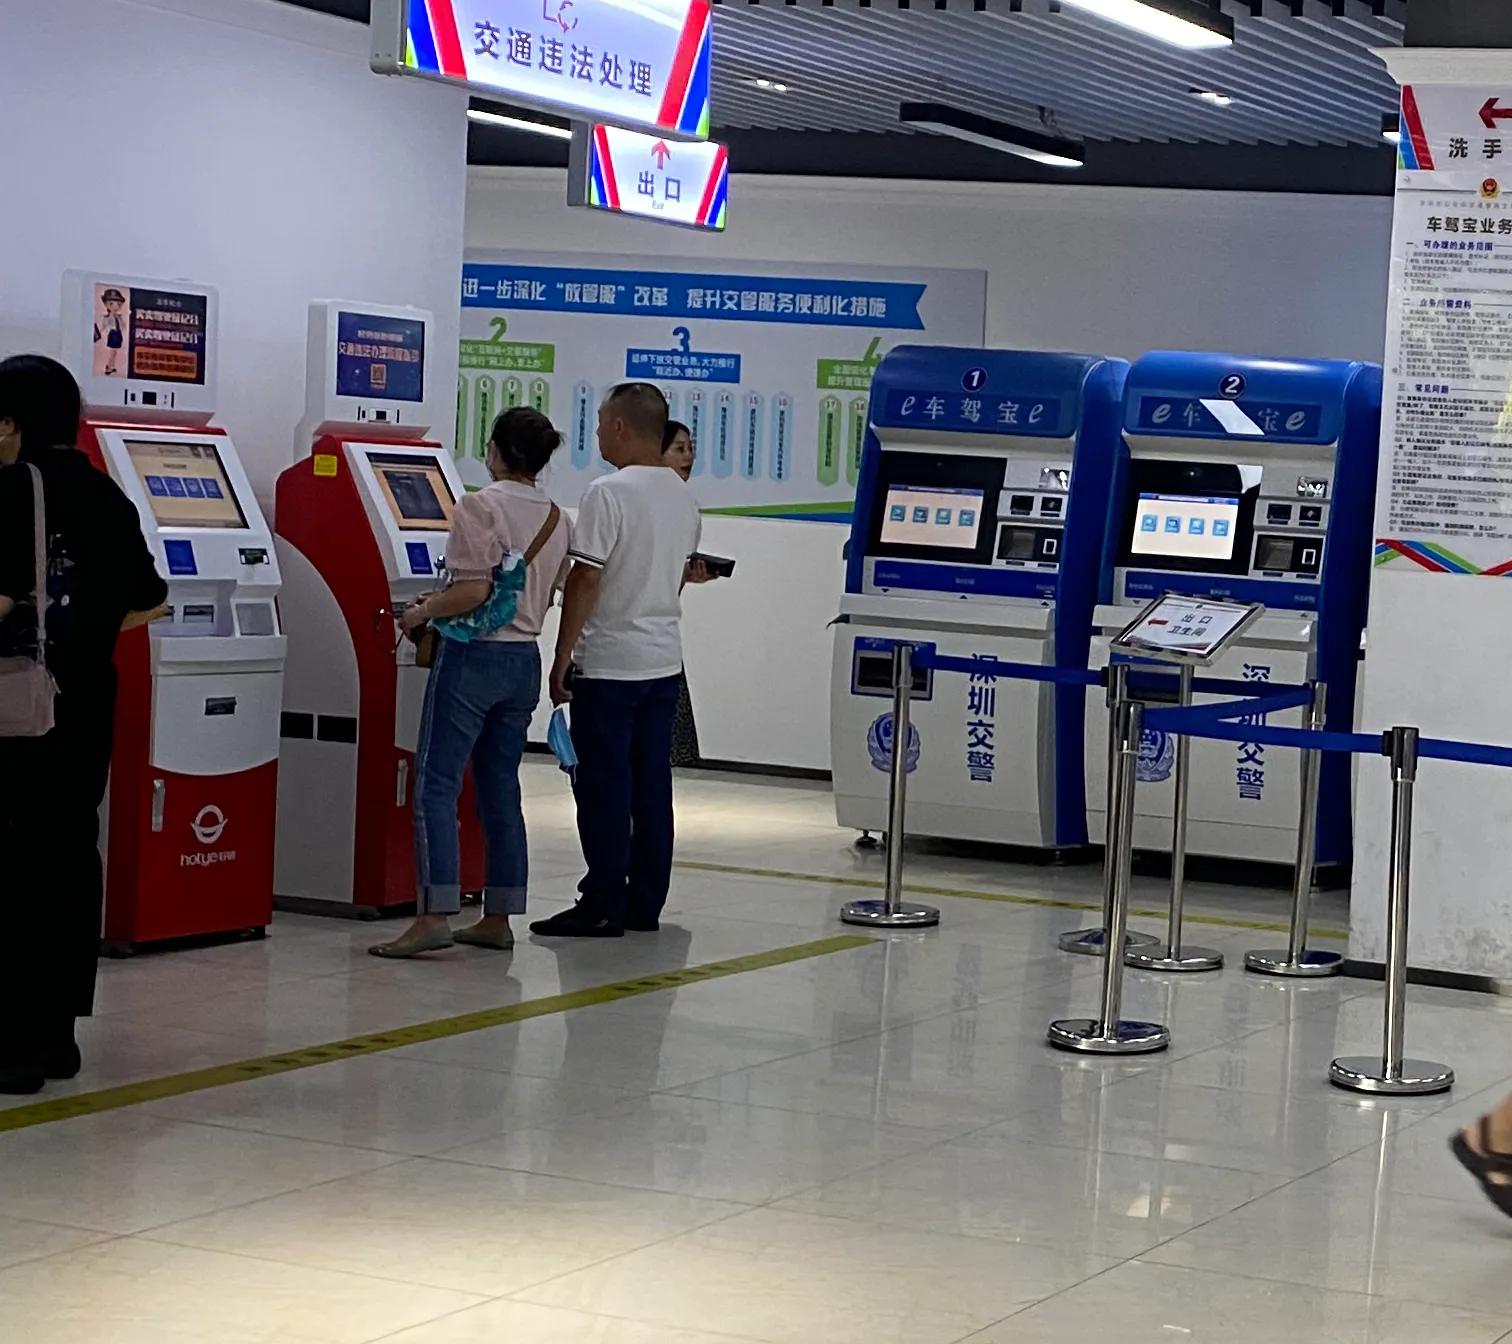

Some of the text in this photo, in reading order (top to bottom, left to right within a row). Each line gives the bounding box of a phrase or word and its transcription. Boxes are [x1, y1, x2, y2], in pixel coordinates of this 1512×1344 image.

[473, 20, 653, 97] 交通违法处理
[638, 171, 681, 202] 出口
[971, 370, 981, 387] 1
[1225, 376, 1240, 394] 2
